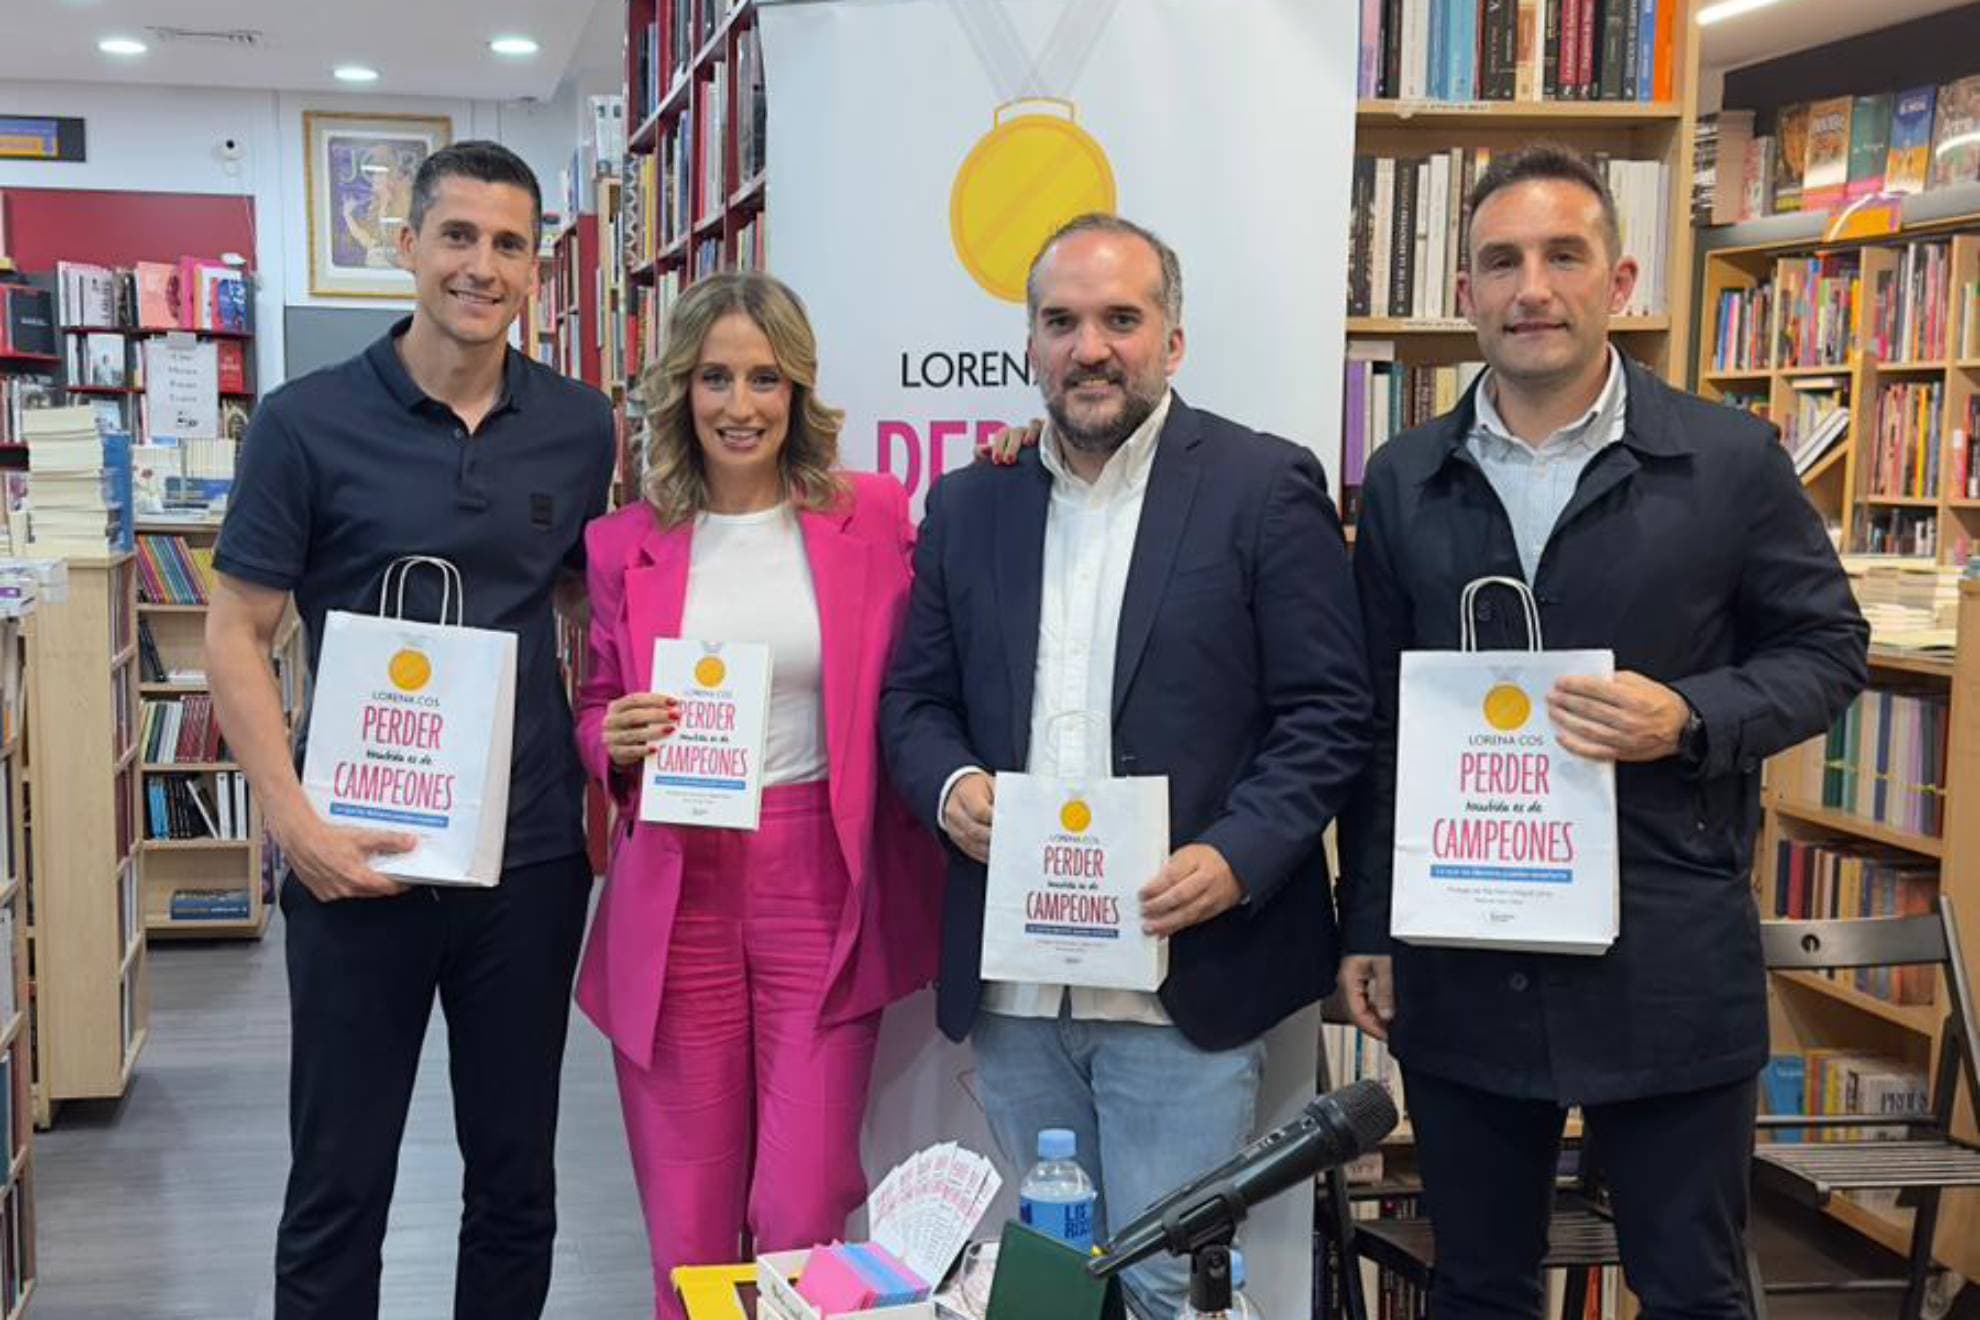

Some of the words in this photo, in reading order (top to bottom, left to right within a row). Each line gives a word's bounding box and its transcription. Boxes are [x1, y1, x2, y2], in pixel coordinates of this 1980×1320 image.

[901, 352, 1034, 387] LOREN
[362, 705, 444, 749] PERDER
[677, 700, 736, 731] PERDER
[656, 744, 748, 777] CAMPEONES
[1460, 752, 1550, 794] PERDER
[333, 762, 456, 811] CAMPEONES
[1432, 818, 1575, 863] CAMPEONES
[1044, 845, 1104, 878] PERDER
[1026, 891, 1120, 925] CAMPEONES
